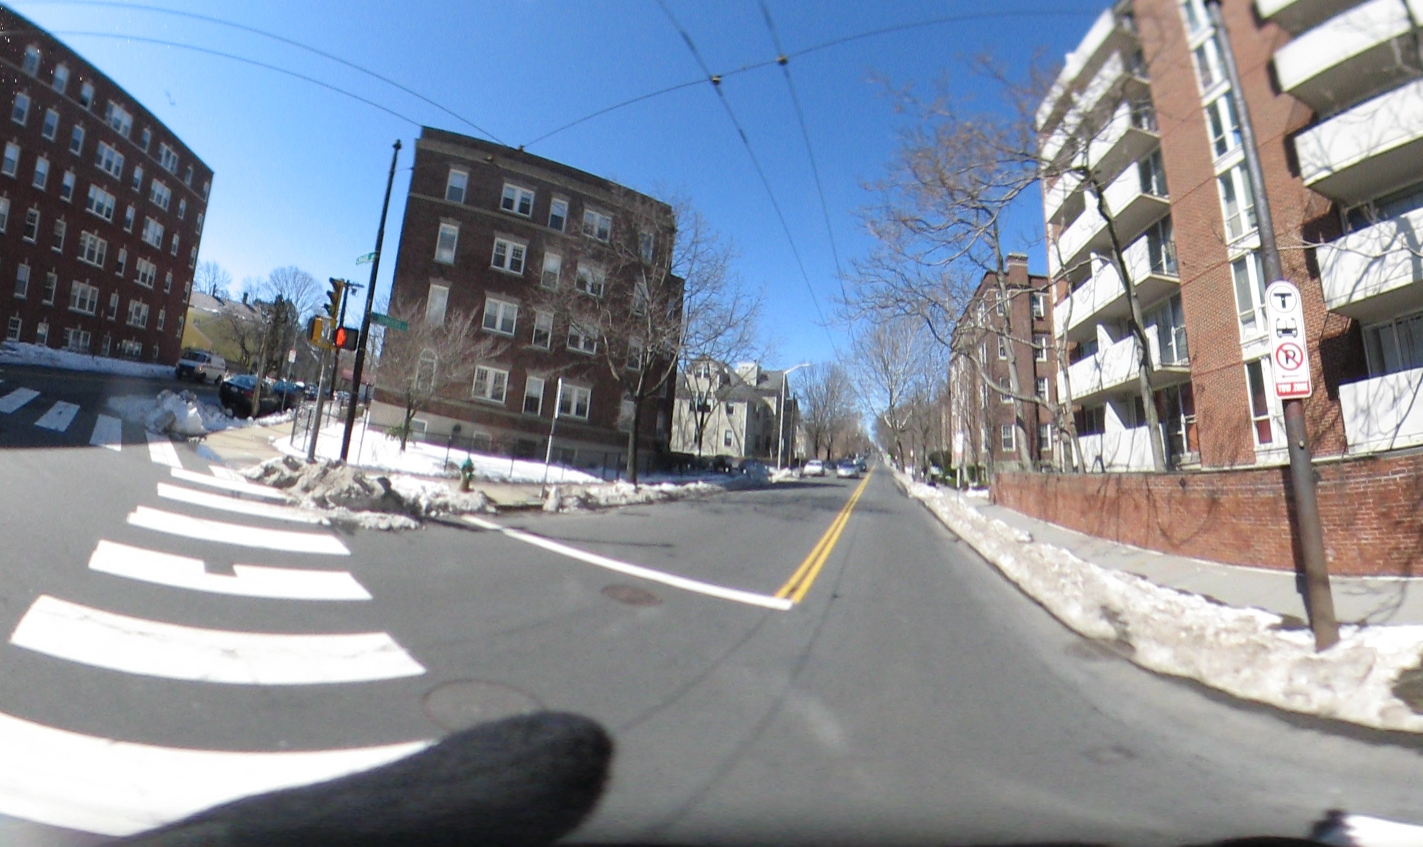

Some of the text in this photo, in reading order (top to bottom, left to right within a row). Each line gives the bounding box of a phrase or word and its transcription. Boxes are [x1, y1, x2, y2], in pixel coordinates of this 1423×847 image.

[1273, 292, 1292, 309] T
[1285, 349, 1296, 365] P
[1278, 383, 1291, 392] TOW
